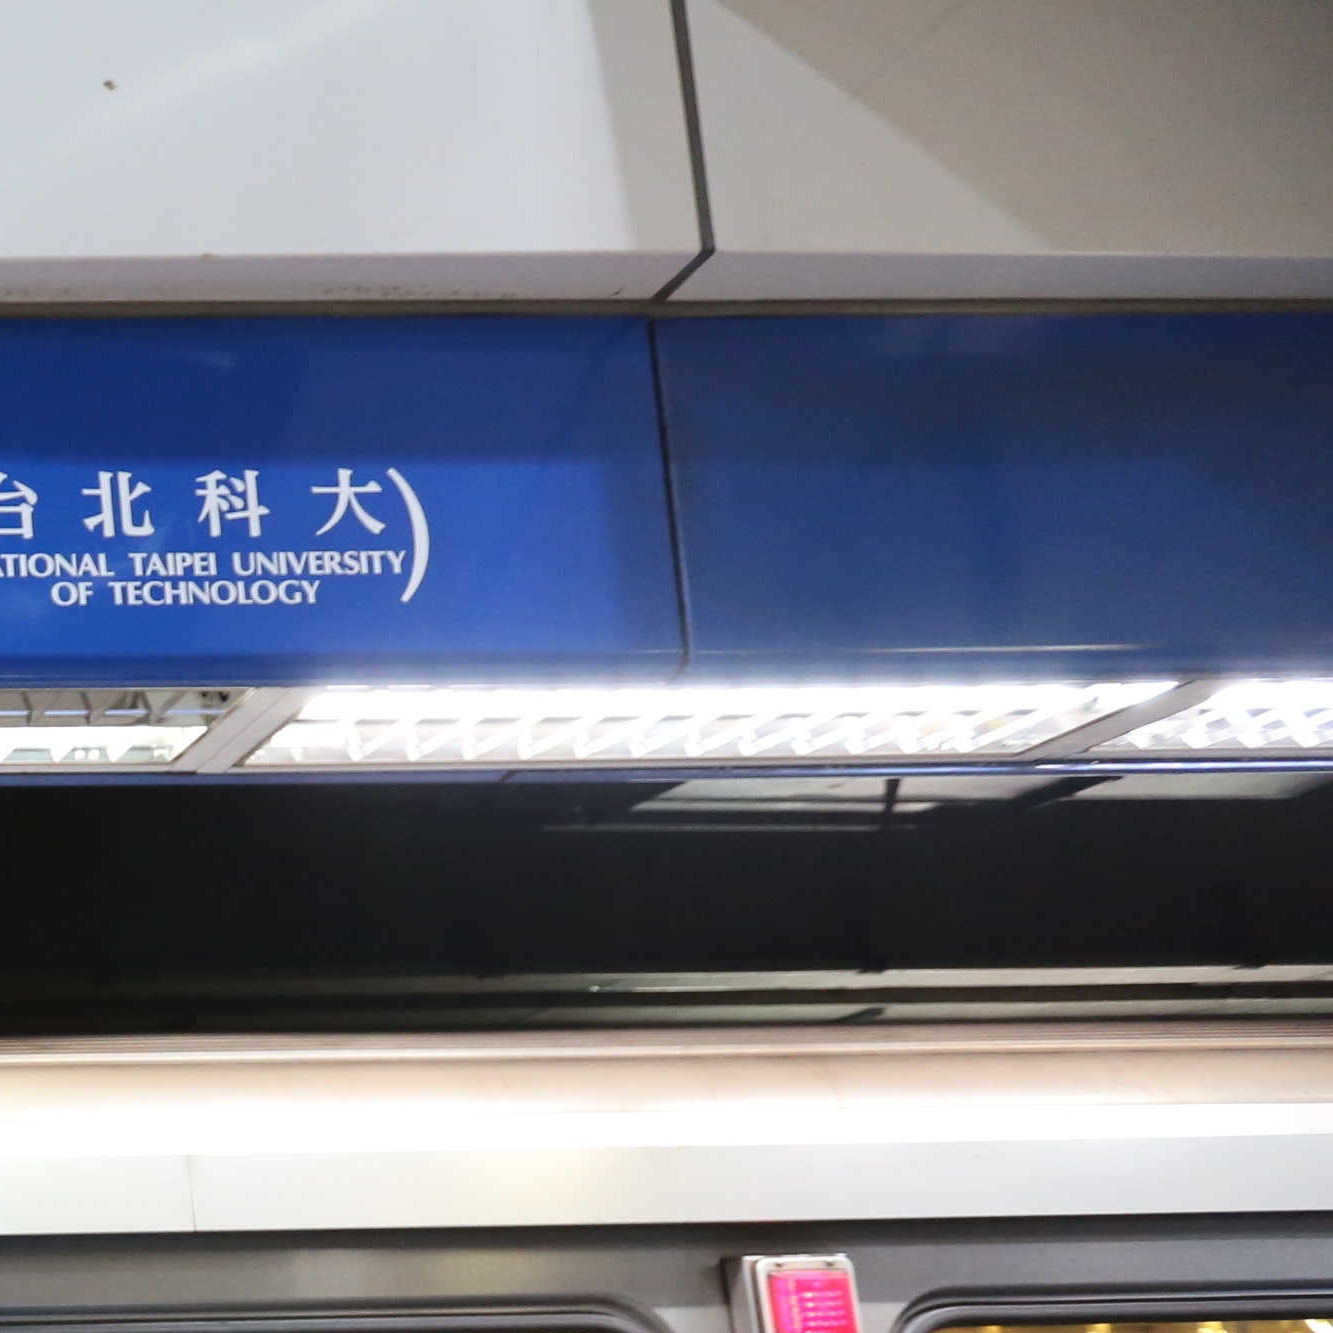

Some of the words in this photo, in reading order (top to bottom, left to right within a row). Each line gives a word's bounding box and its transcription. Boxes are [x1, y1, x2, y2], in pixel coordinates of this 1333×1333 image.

[129, 551, 218, 577] TAIPEI
[234, 549, 406, 576] UNIVERSITY
[51, 580, 93, 607] OF
[109, 579, 321, 606] TECHNOLOGY
